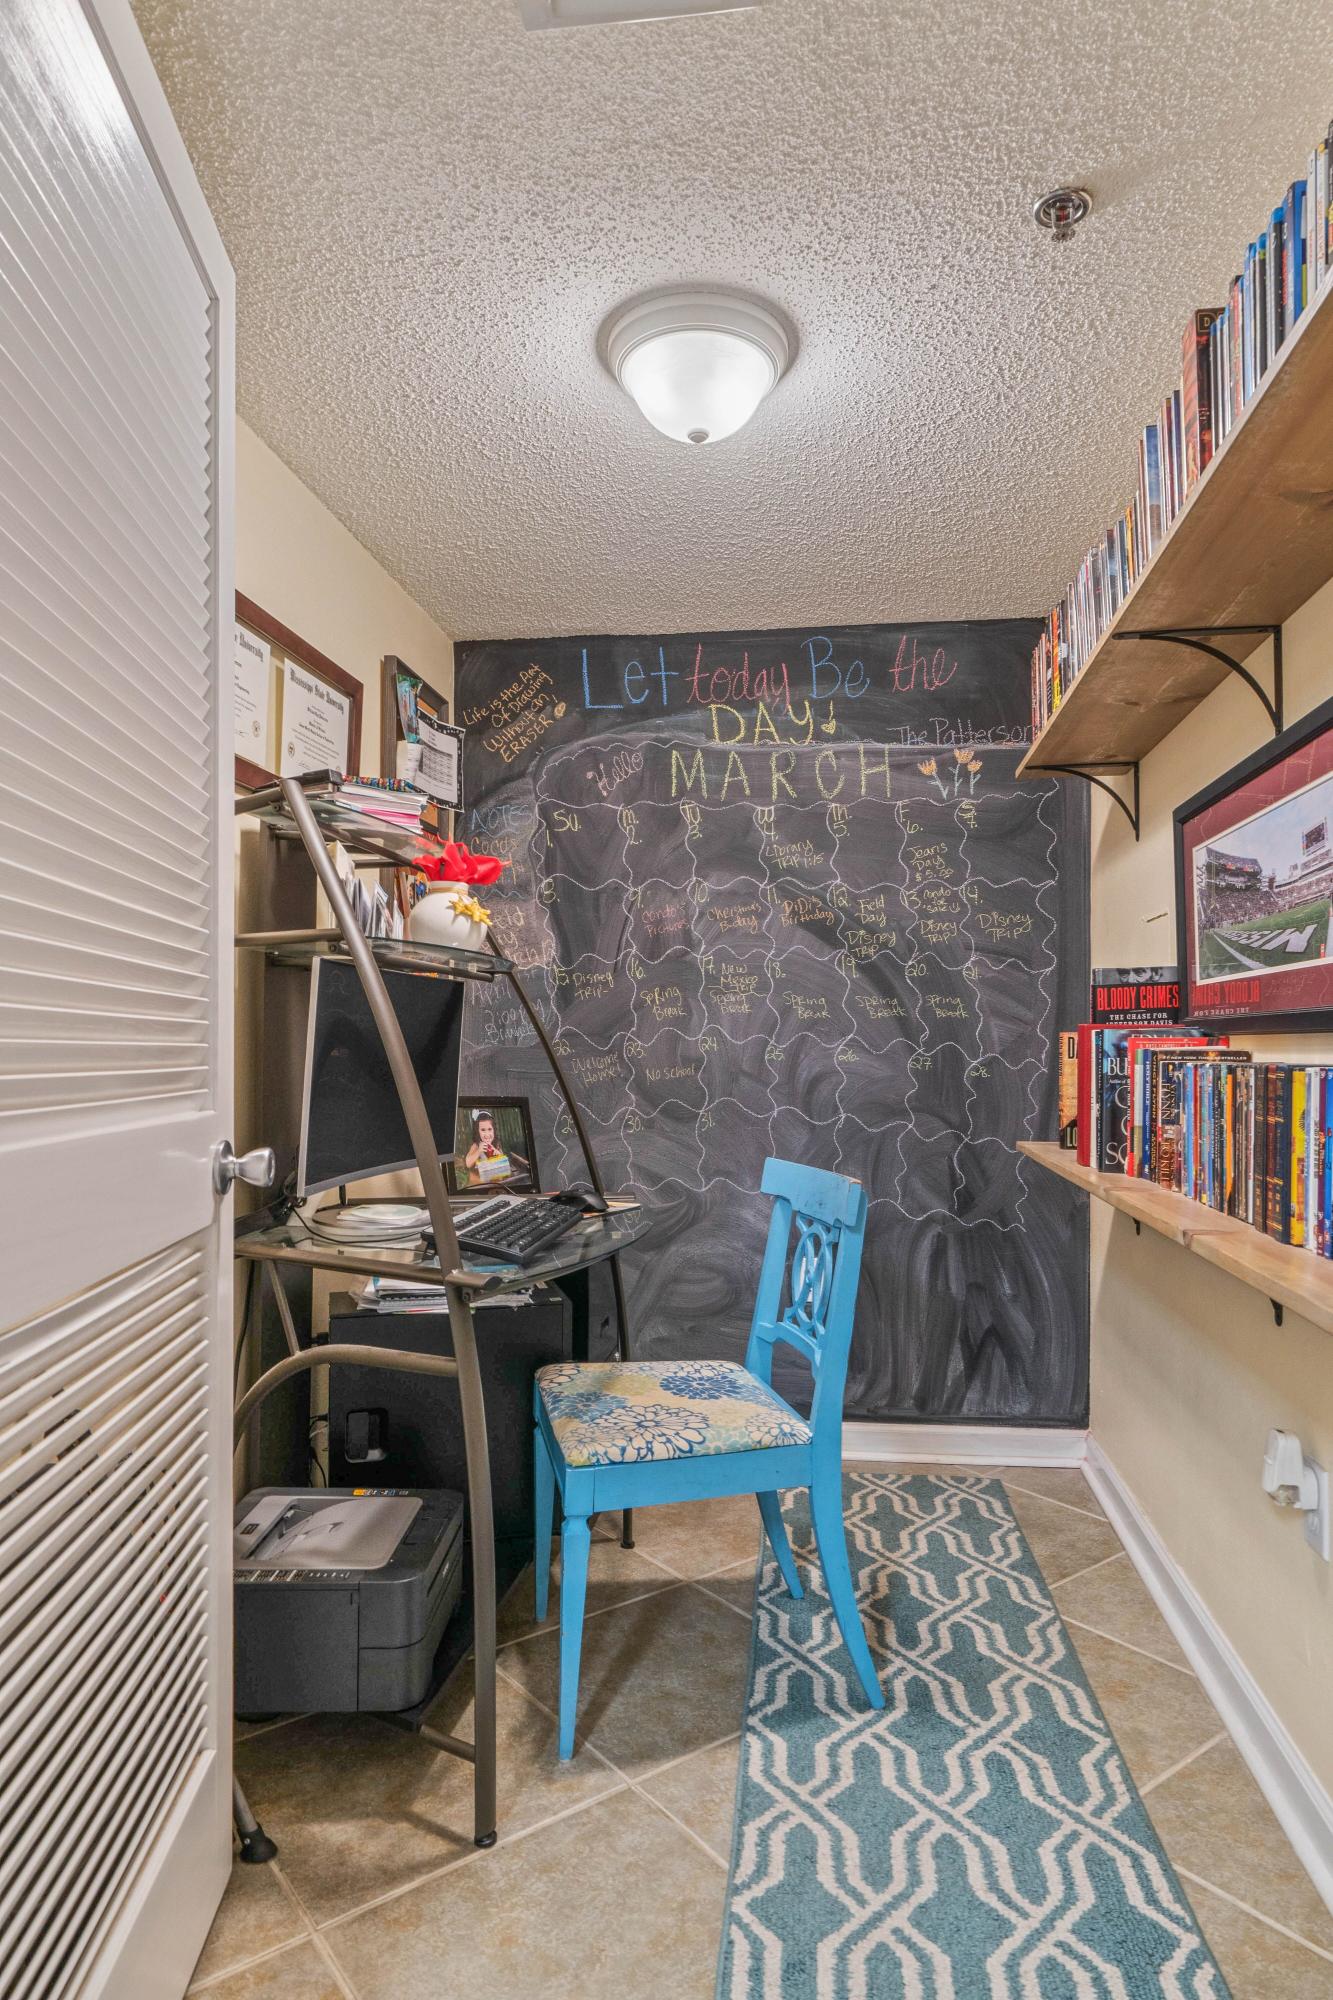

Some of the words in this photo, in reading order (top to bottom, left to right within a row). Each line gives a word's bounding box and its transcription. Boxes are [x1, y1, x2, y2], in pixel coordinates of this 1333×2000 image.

[582, 645, 680, 709] Let
[685, 642, 793, 715] today
[801, 636, 870, 700] Be
[889, 635, 958, 693] the
[462, 706, 490, 725] Life
[500, 682, 524, 701] the
[508, 671, 553, 713] Drawing
[886, 726, 928, 746] The
[584, 751, 644, 797] Hello
[671, 746, 891, 804] MARCH
[917, 920, 957, 937] Disney
[976, 912, 1034, 933] Disney
[845, 930, 896, 948] Disney
[573, 972, 614, 988] Disney
[1096, 986, 1137, 1011] BLOODY
[1139, 984, 1179, 1008] CRIMES
[1109, 1013, 1125, 1021] THE
[1126, 1012, 1151, 1020] CHASE
[1152, 1011, 1168, 1019] FOR
